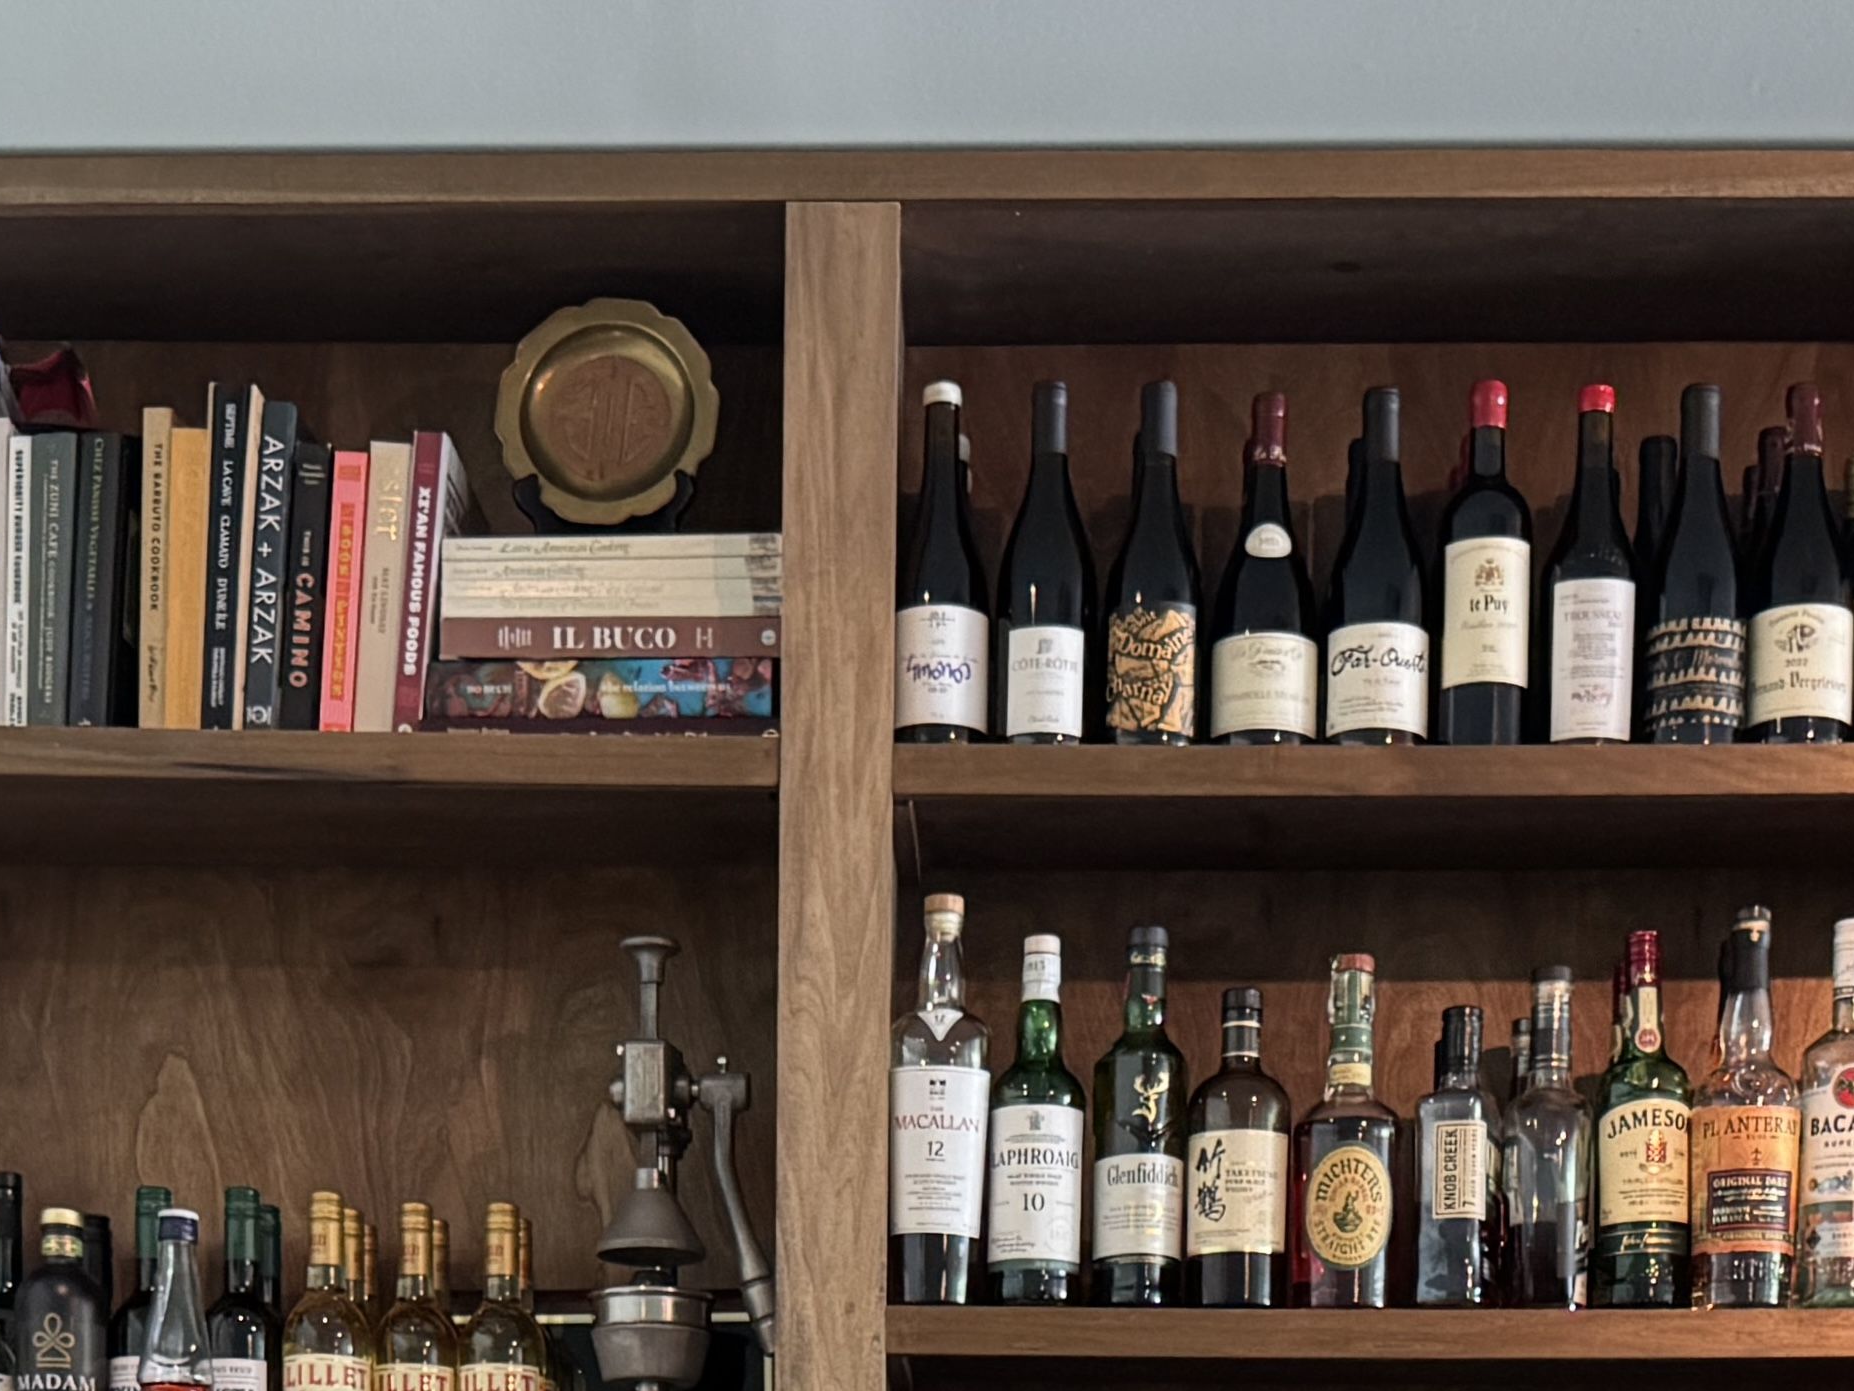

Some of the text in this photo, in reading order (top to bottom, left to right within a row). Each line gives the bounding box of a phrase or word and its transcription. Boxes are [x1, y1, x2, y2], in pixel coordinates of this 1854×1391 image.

[149, 443, 163, 612] THE BARBUTO COOKBOOK
[250, 435, 285, 665] ARZAK + ARZAK
[403, 486, 431, 676] XI'AN FAMOUS FOODS
[289, 572, 314, 688] CAMINO
[553, 626, 677, 649] IL BUCO
[895, 1114, 980, 1132] MACALLAN
[1607, 1107, 1691, 1139] JAMESO
[927, 1141, 945, 1157] 12
[991, 1148, 1079, 1170] LAPHROAIG
[1107, 1162, 1178, 1187] Glenfiddich
[1316, 1157, 1383, 1203] MICHTER'S
[1444, 1128, 1457, 1210] KNOB CREEK
[1023, 1192, 1045, 1212] 10
[286, 1364, 366, 1388] LILLET
